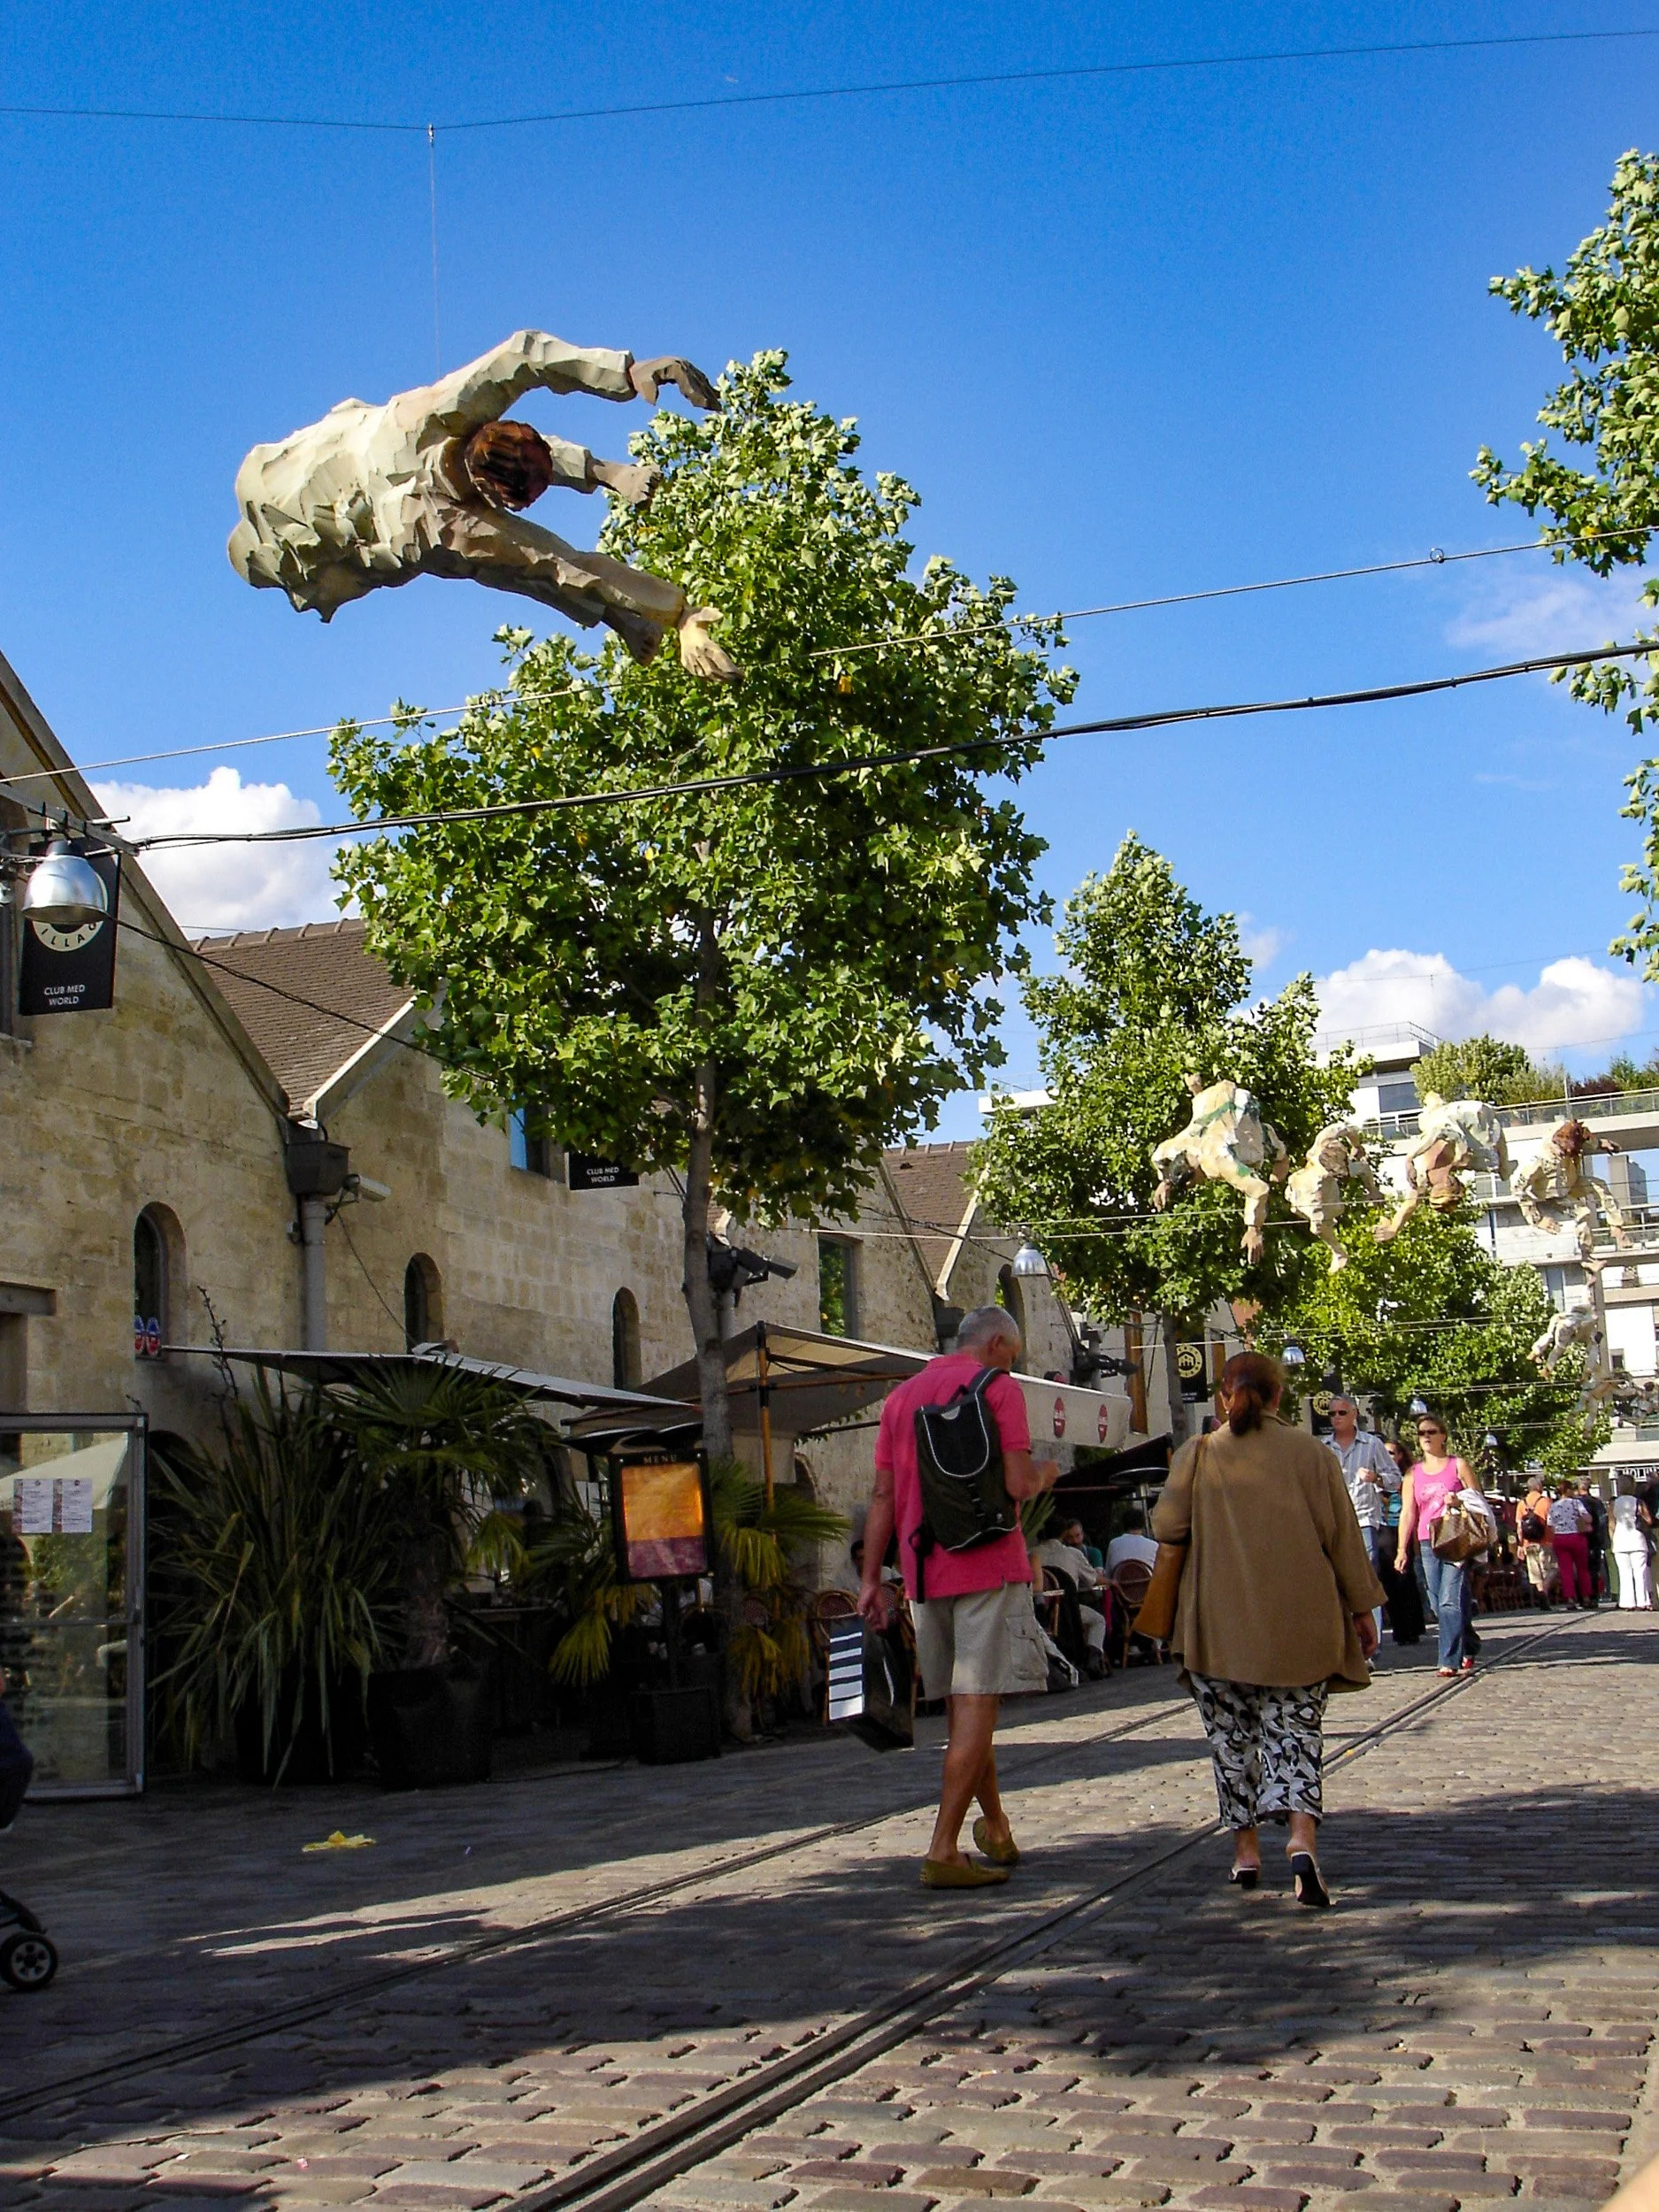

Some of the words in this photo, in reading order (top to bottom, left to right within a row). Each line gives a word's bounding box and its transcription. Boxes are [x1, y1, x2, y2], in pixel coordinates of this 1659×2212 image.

[44, 987, 65, 995] CLUB
[66, 984, 86, 993] MED
[49, 996, 80, 1006] WORLD
[643, 1454, 677, 1464] MENU
